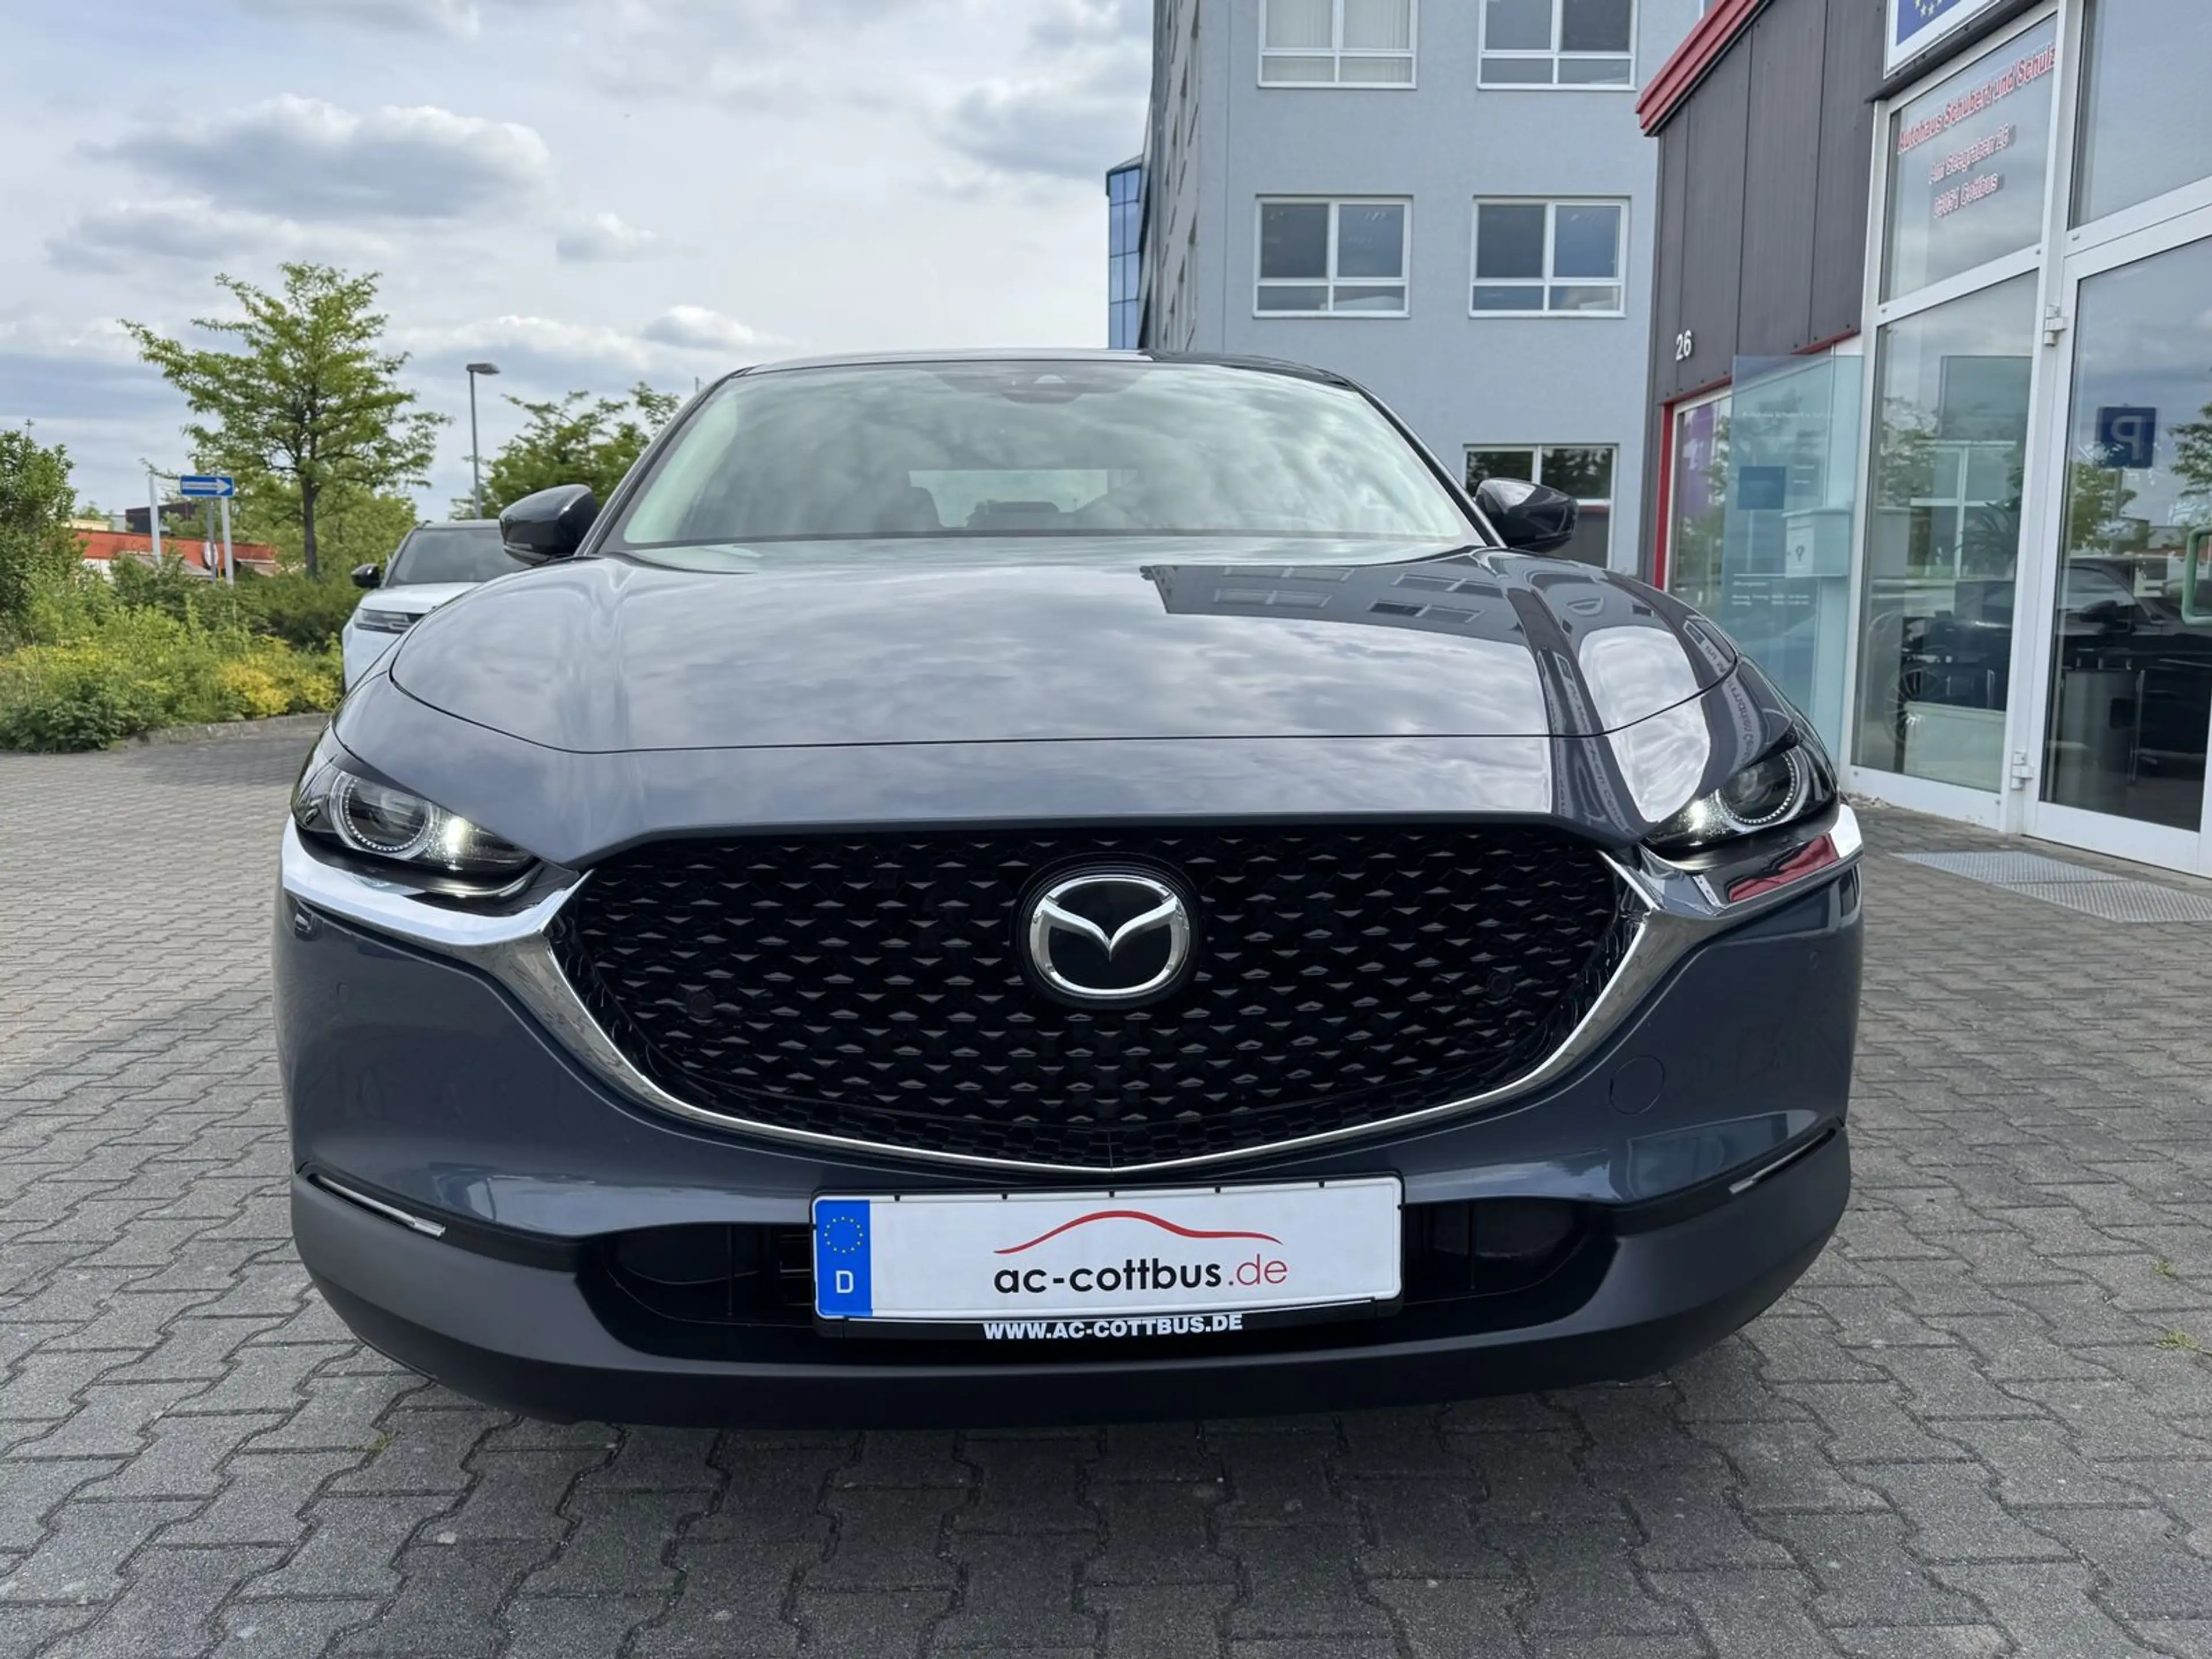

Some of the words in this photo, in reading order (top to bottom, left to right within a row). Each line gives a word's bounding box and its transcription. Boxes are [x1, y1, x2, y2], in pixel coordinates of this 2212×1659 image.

[1993, 64, 2017, 99] und
[1676, 329, 1692, 361] 26
[836, 1270, 854, 1293] D
[984, 1314, 1243, 1340] WWW.AC-COTTBUS.DE
